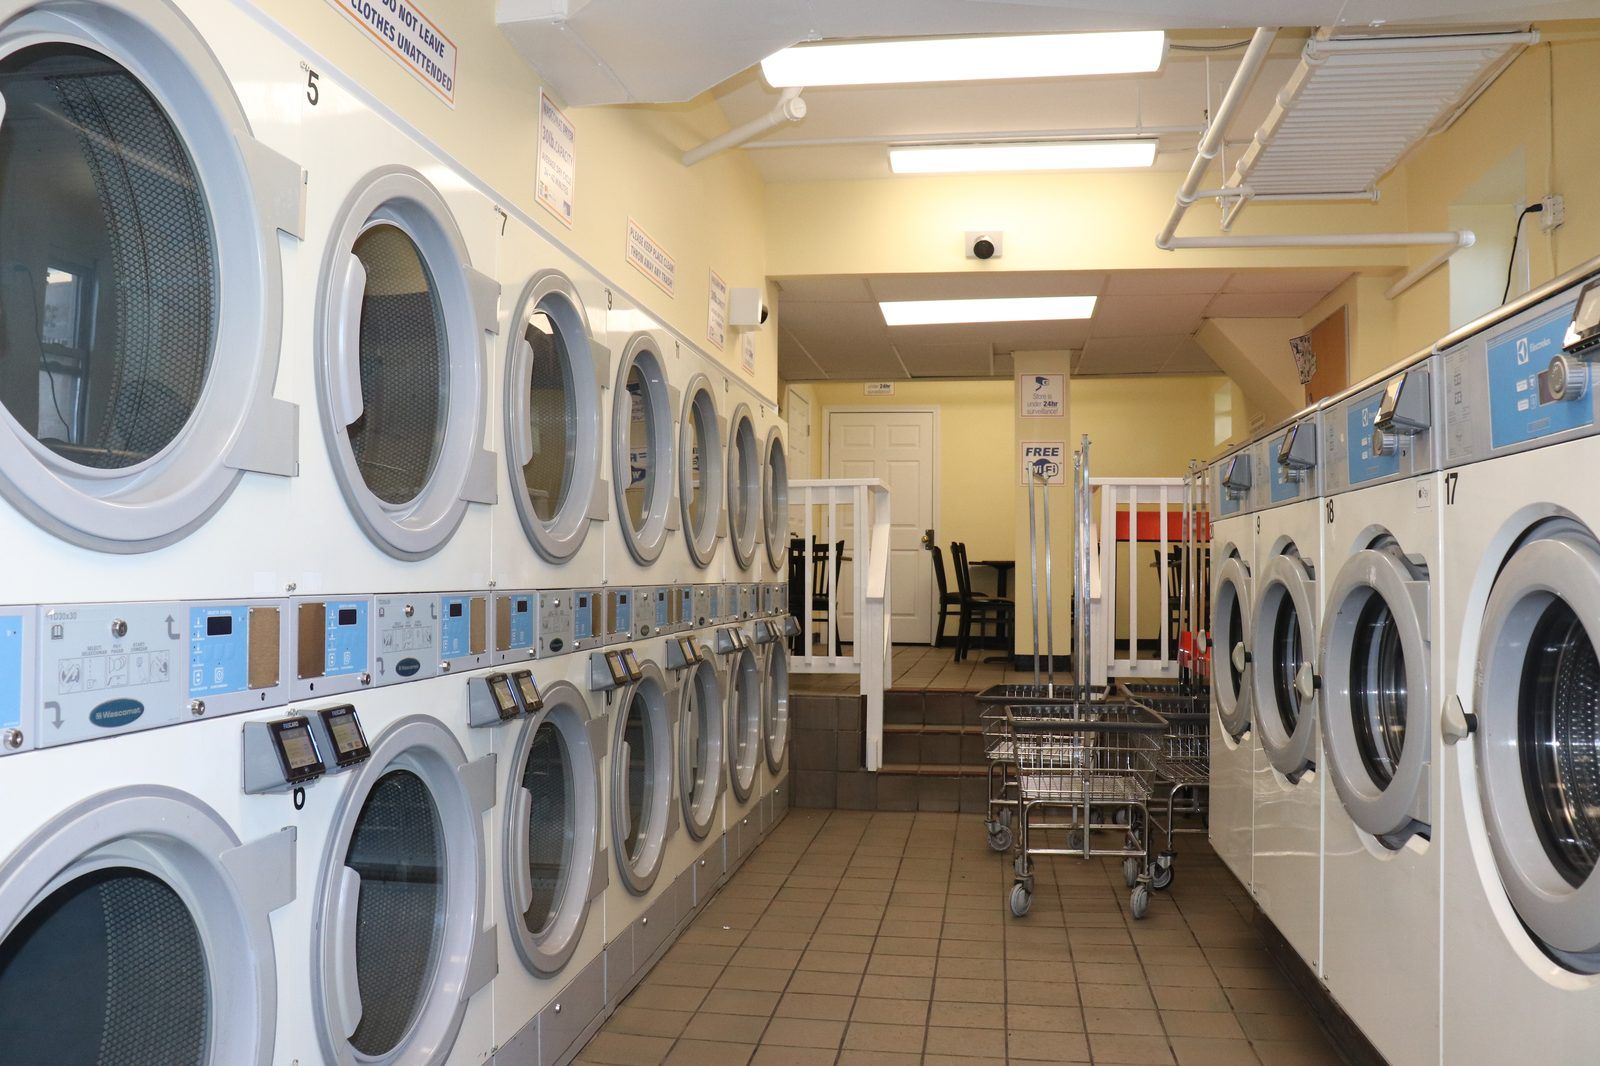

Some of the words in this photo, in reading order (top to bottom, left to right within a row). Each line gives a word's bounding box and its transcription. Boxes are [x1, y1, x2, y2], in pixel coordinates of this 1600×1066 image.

[398, 4, 418, 32] NOT
[419, 23, 445, 58] LEAVE
[397, 32, 453, 92] UNATTENDED
[306, 69, 319, 106] 5
[500, 211, 508, 236] 7
[630, 226, 644, 247] PLEASE
[661, 270, 674, 289] TRASH
[1032, 392, 1047, 400] Store
[1025, 447, 1060, 457] FREE
[1445, 472, 1459, 505] 17
[1326, 498, 1335, 524] 18
